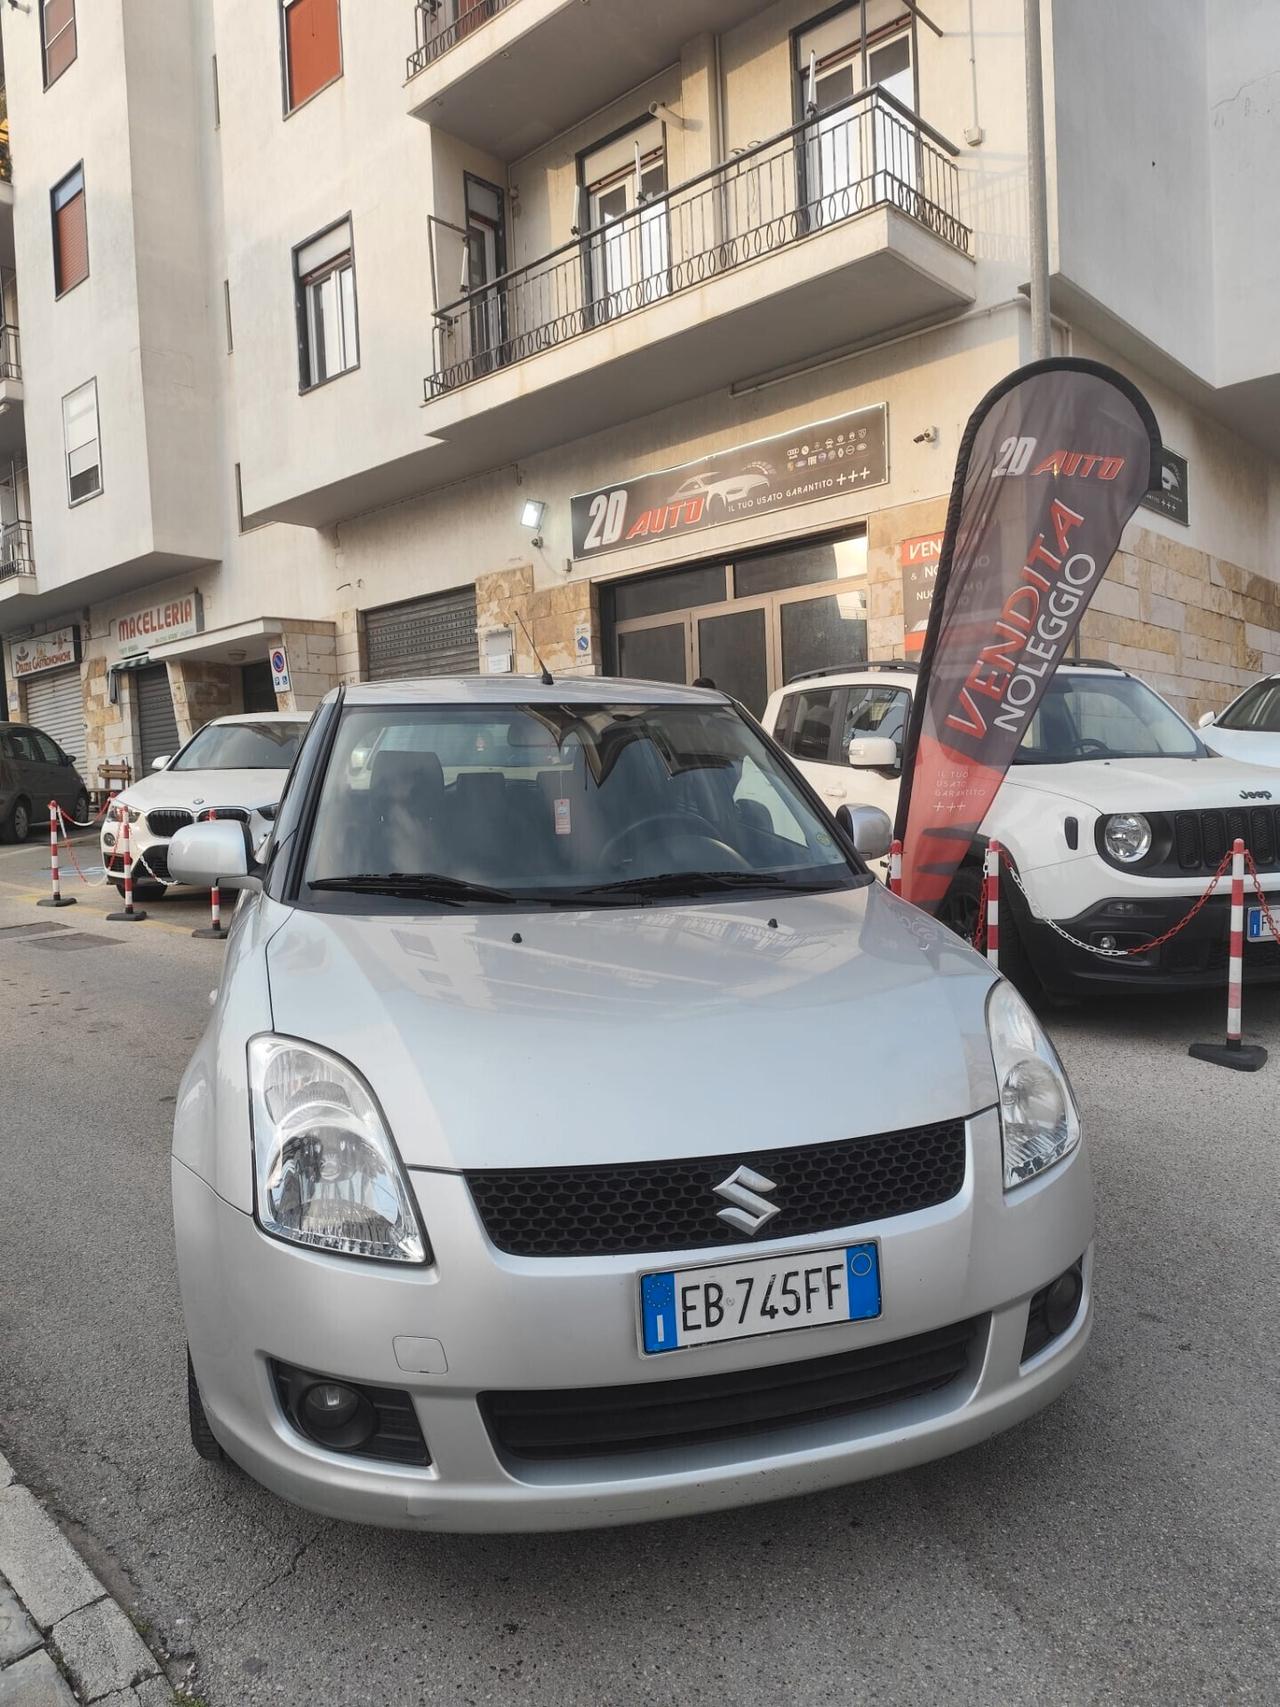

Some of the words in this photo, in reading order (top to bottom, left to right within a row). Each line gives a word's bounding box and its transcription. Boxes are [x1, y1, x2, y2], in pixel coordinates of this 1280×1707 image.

[991, 435, 1038, 479] 2D
[1031, 449, 1128, 482] AUTO
[728, 504, 735, 512] IL
[738, 501, 753, 510] TUO
[757, 492, 783, 504] USATO
[786, 478, 833, 497] GARANTITO
[583, 489, 628, 550] 2D
[625, 496, 705, 539] AUTO
[118, 598, 193, 642] MACELLERIA
[944, 497, 1087, 741] VENDITA
[992, 552, 1096, 733] NOLEGGIO
[934, 788, 986, 798] GARANTITO
[936, 779, 967, 788] USATO
[951, 769, 969, 778] TUO
[1239, 789, 1272, 801] Jeep
